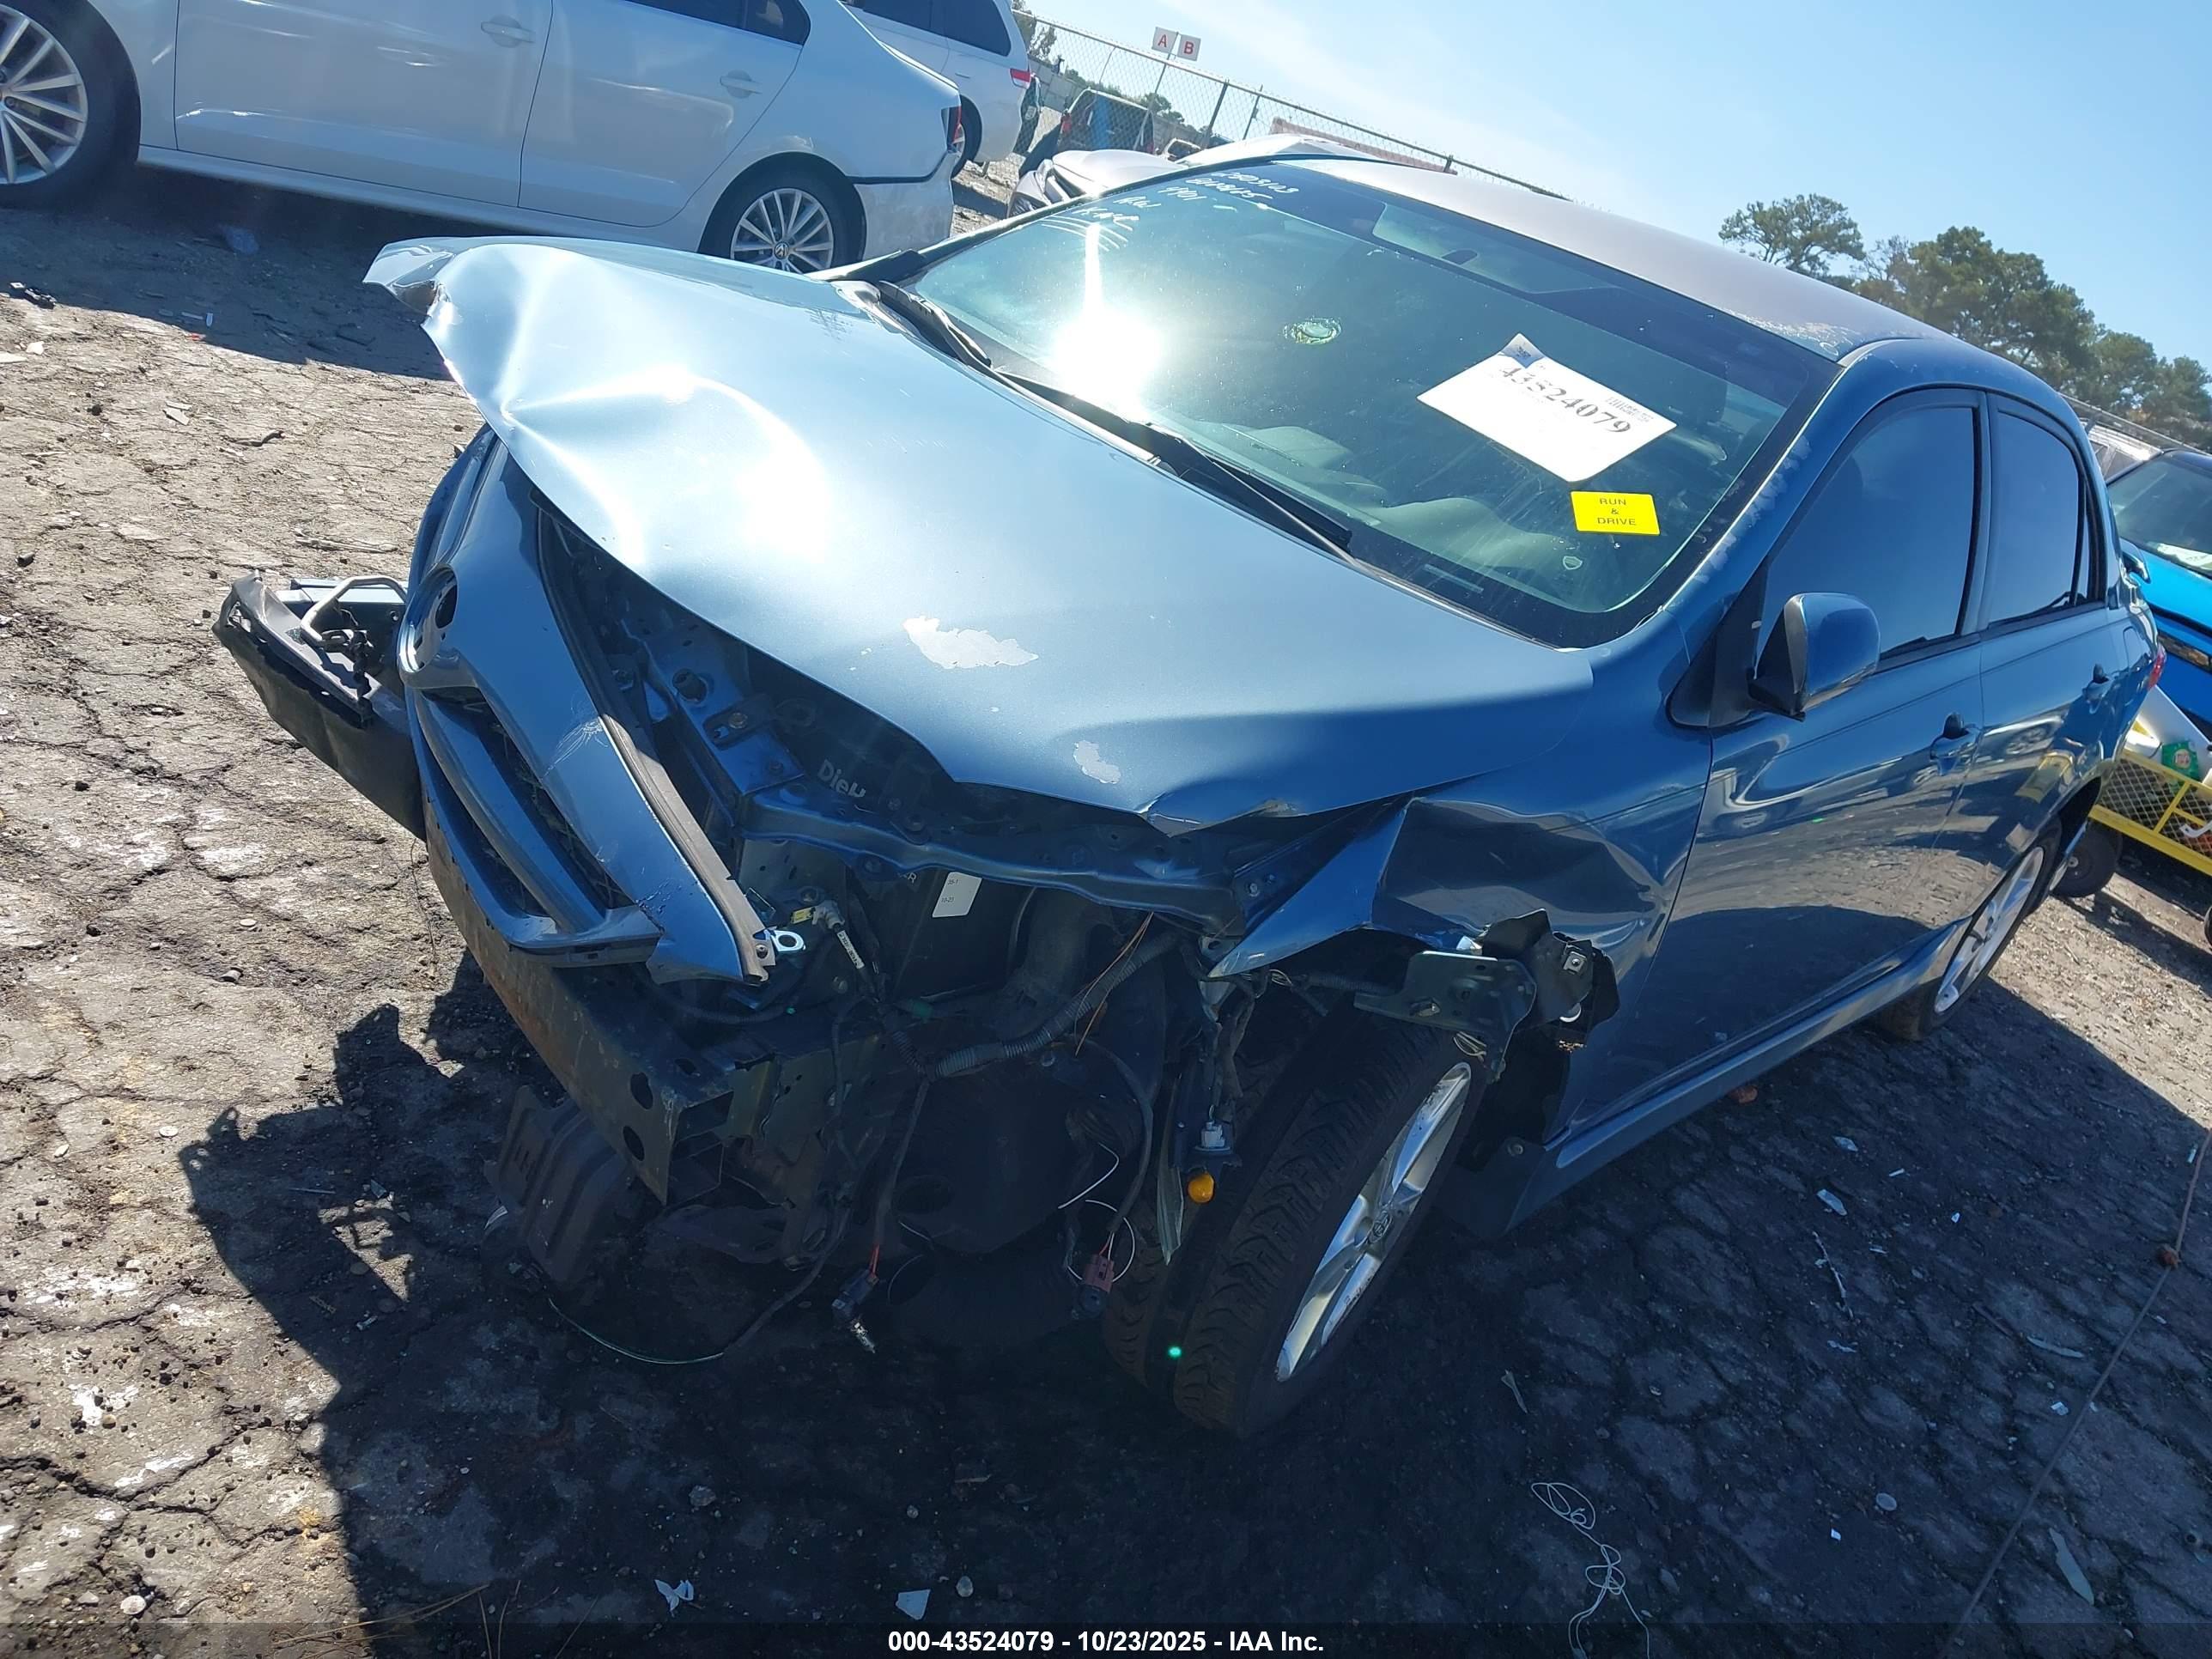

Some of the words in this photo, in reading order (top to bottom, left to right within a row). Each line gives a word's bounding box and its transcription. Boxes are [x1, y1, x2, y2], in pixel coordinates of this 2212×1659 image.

[1158, 33, 1167, 47] A
[1183, 40, 1194, 54] B
[1502, 368, 1632, 433] 43524079
[1599, 497, 1627, 506] RUN
[1597, 517, 1637, 526] DRIVE
